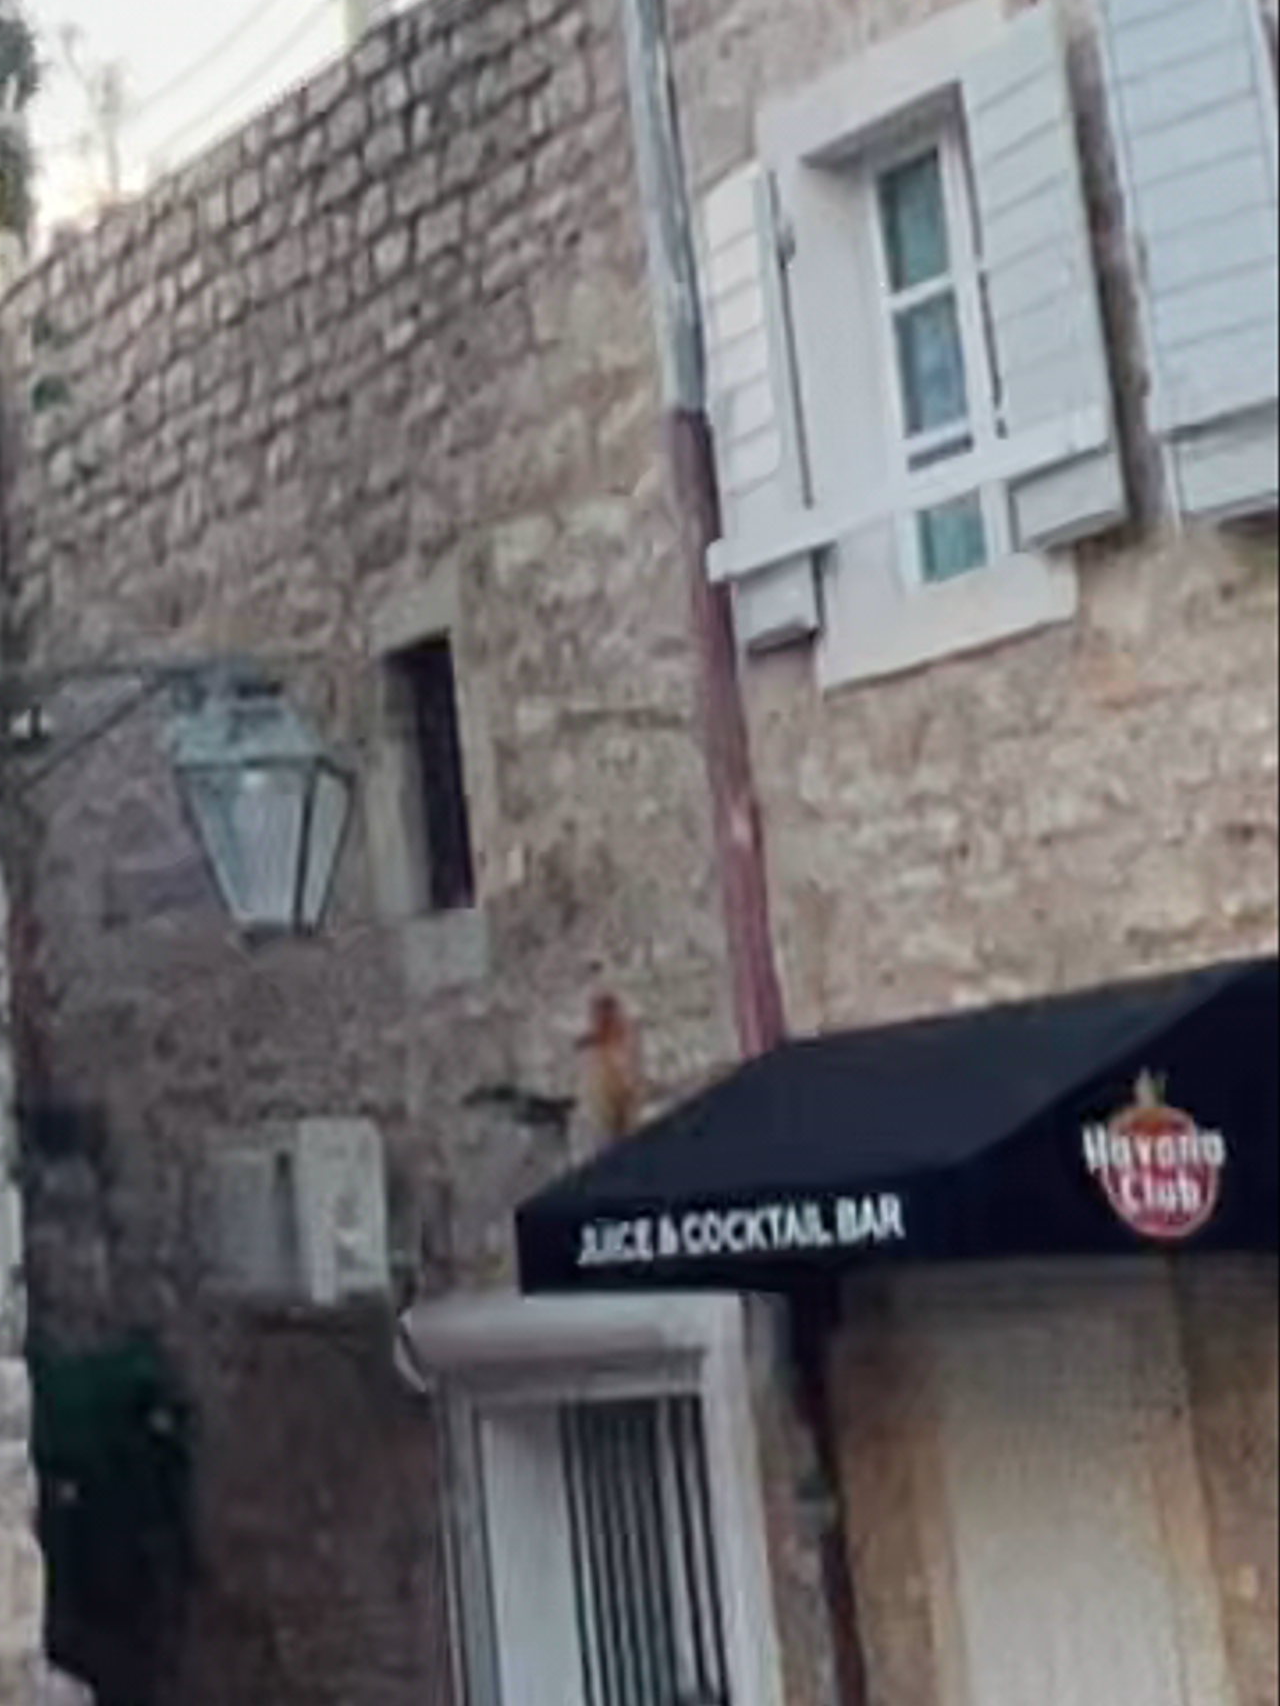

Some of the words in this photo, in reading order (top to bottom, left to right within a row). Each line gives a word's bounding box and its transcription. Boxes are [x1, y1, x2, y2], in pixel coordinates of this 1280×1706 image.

[1082, 1122, 1225, 1174] Havana
[1119, 1168, 1201, 1213] Club
[682, 1201, 832, 1255] COCKTAIL
[835, 1191, 906, 1245] BAR
